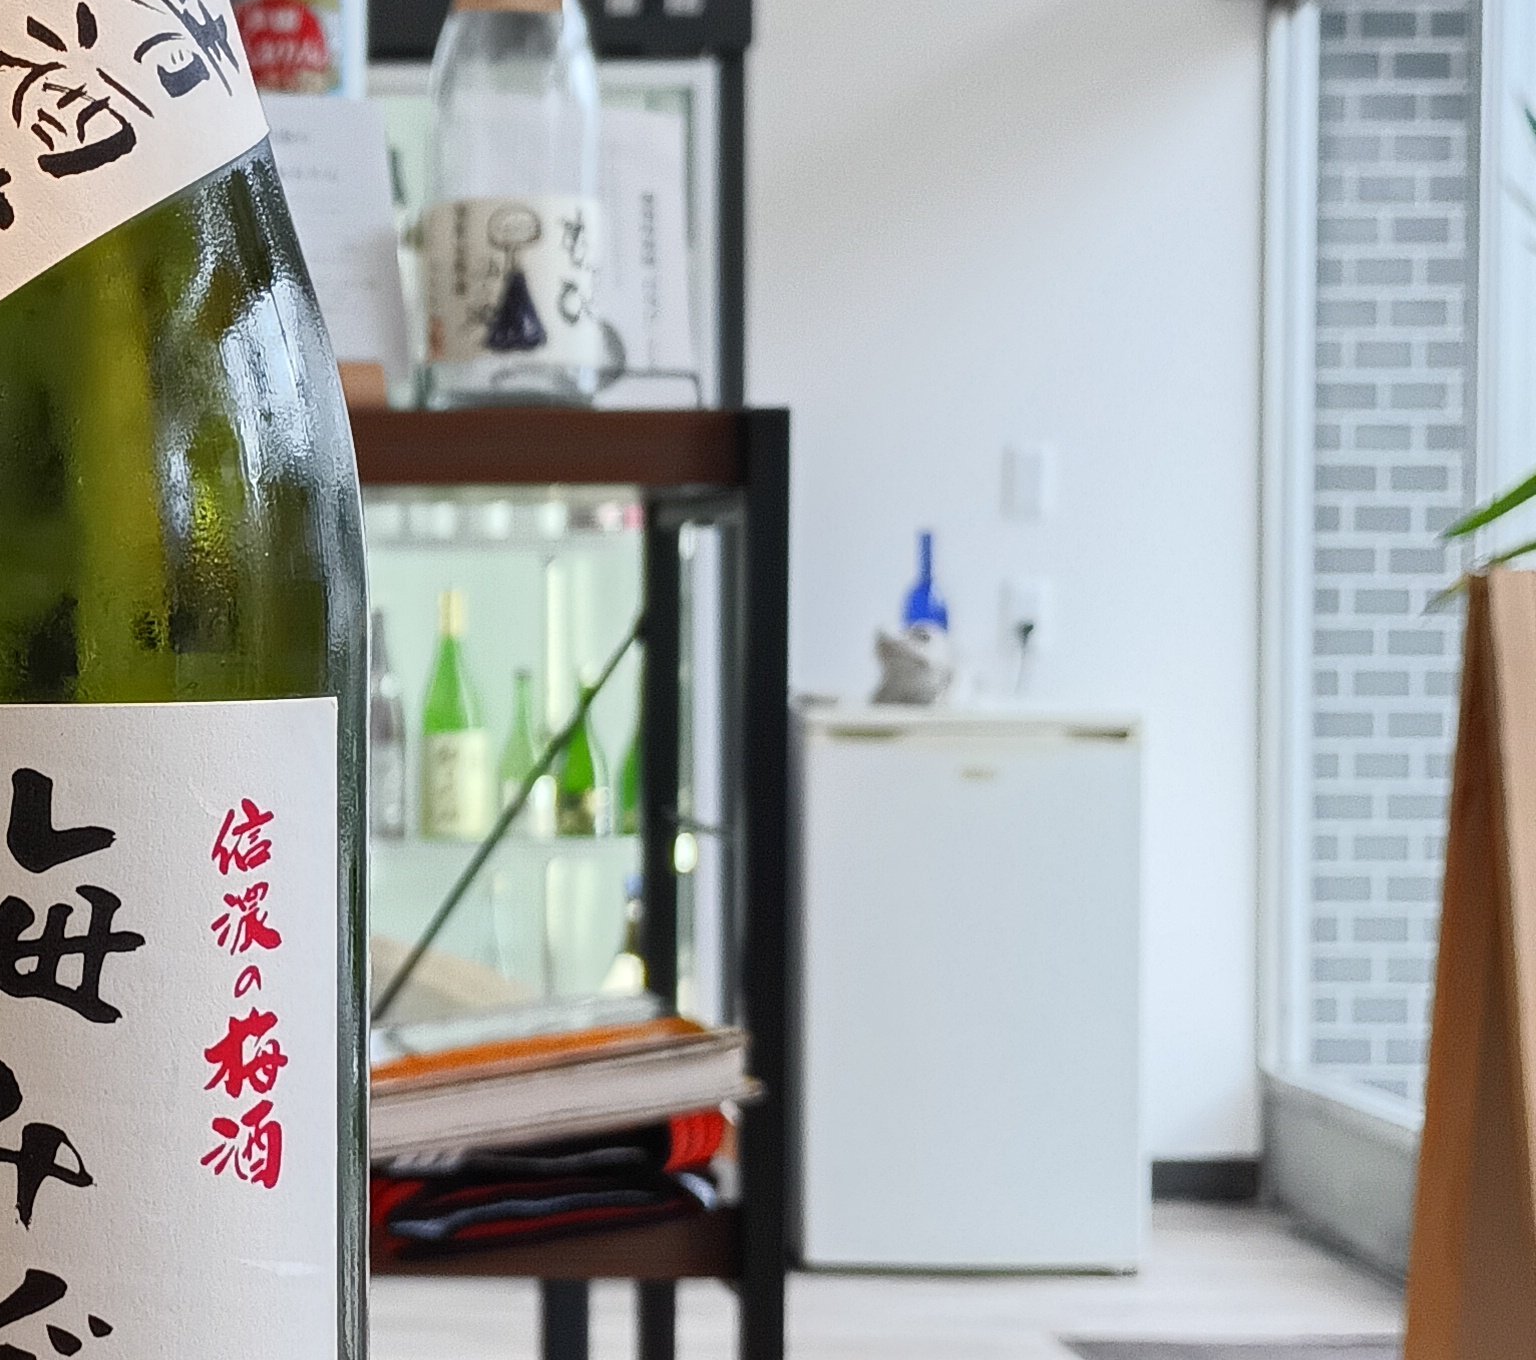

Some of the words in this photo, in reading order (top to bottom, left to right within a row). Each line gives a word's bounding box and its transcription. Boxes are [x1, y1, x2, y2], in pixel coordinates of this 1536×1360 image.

[200, 798, 288, 1189] 信濃の梅酒
